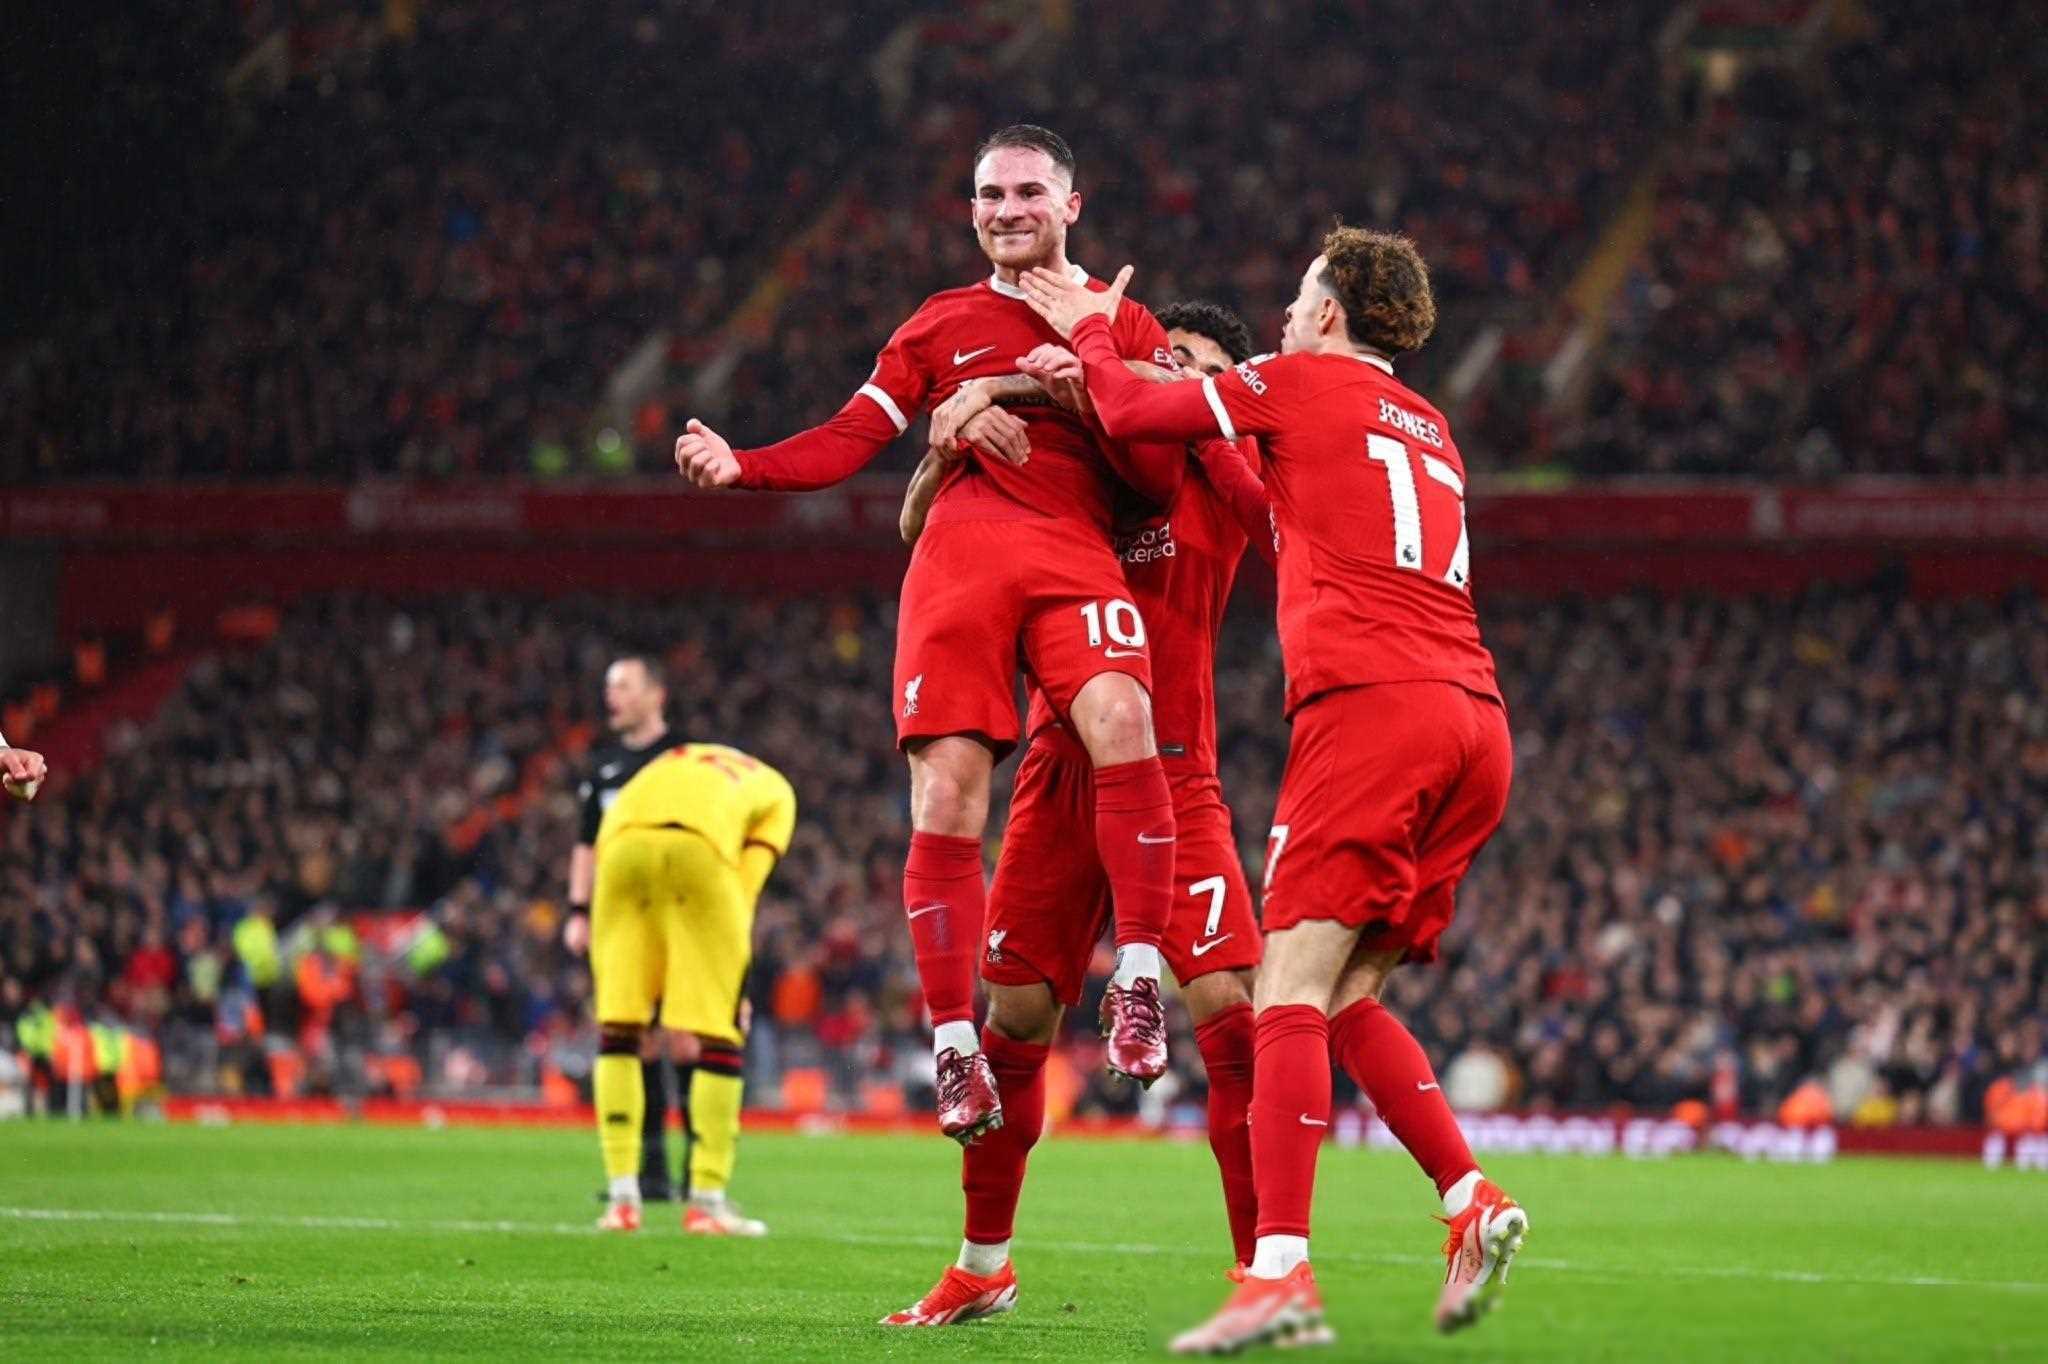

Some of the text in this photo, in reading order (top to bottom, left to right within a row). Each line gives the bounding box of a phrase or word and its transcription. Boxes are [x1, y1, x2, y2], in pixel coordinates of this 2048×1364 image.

[1378, 397, 1443, 449] JONES
[1366, 433, 1470, 591] 17
[1080, 598, 1146, 648] 10
[1189, 875, 1227, 936] 7
